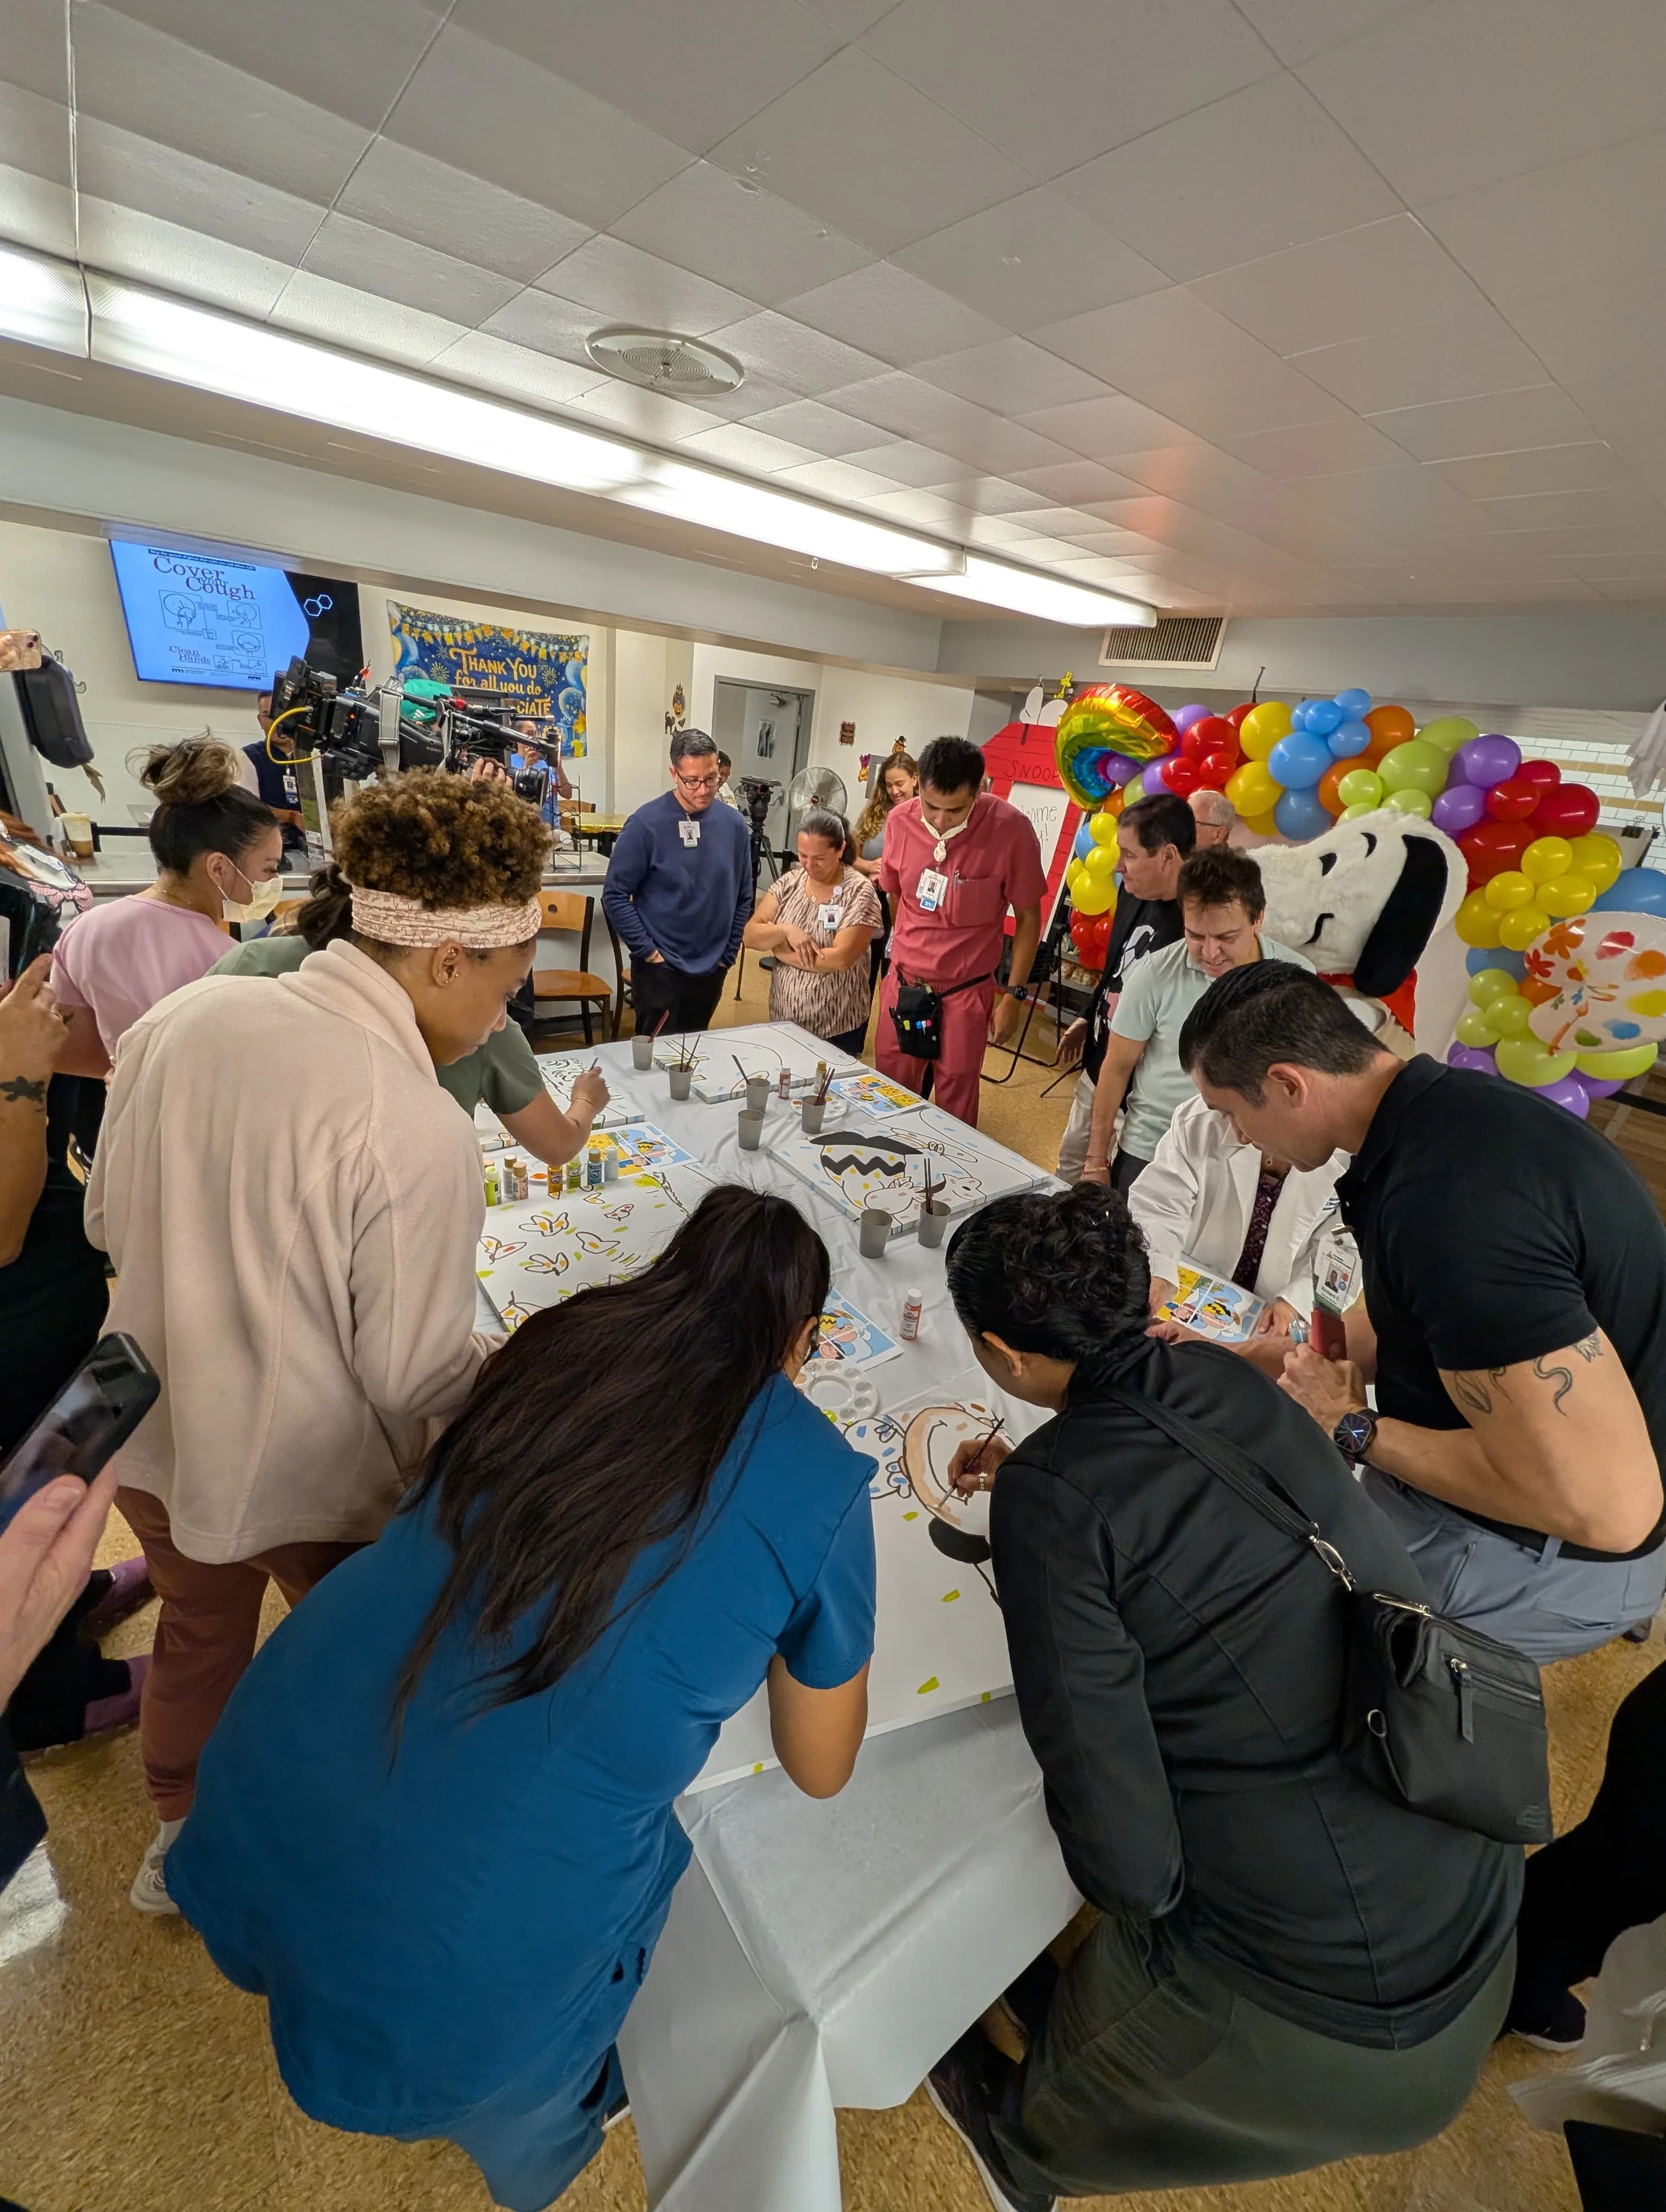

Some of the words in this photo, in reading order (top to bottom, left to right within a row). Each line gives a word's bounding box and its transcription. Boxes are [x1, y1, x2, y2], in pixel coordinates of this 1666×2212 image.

[153, 556, 225, 581] Cover
[185, 576, 256, 601] Cough
[169, 646, 199, 655] Clean
[178, 653, 211, 663] Hands
[449, 646, 508, 675] THANK
[506, 657, 537, 681] YOU
[455, 669, 478, 687] for
[480, 674, 497, 690] all
[500, 681, 525, 695] you
[527, 680, 542, 695] do
